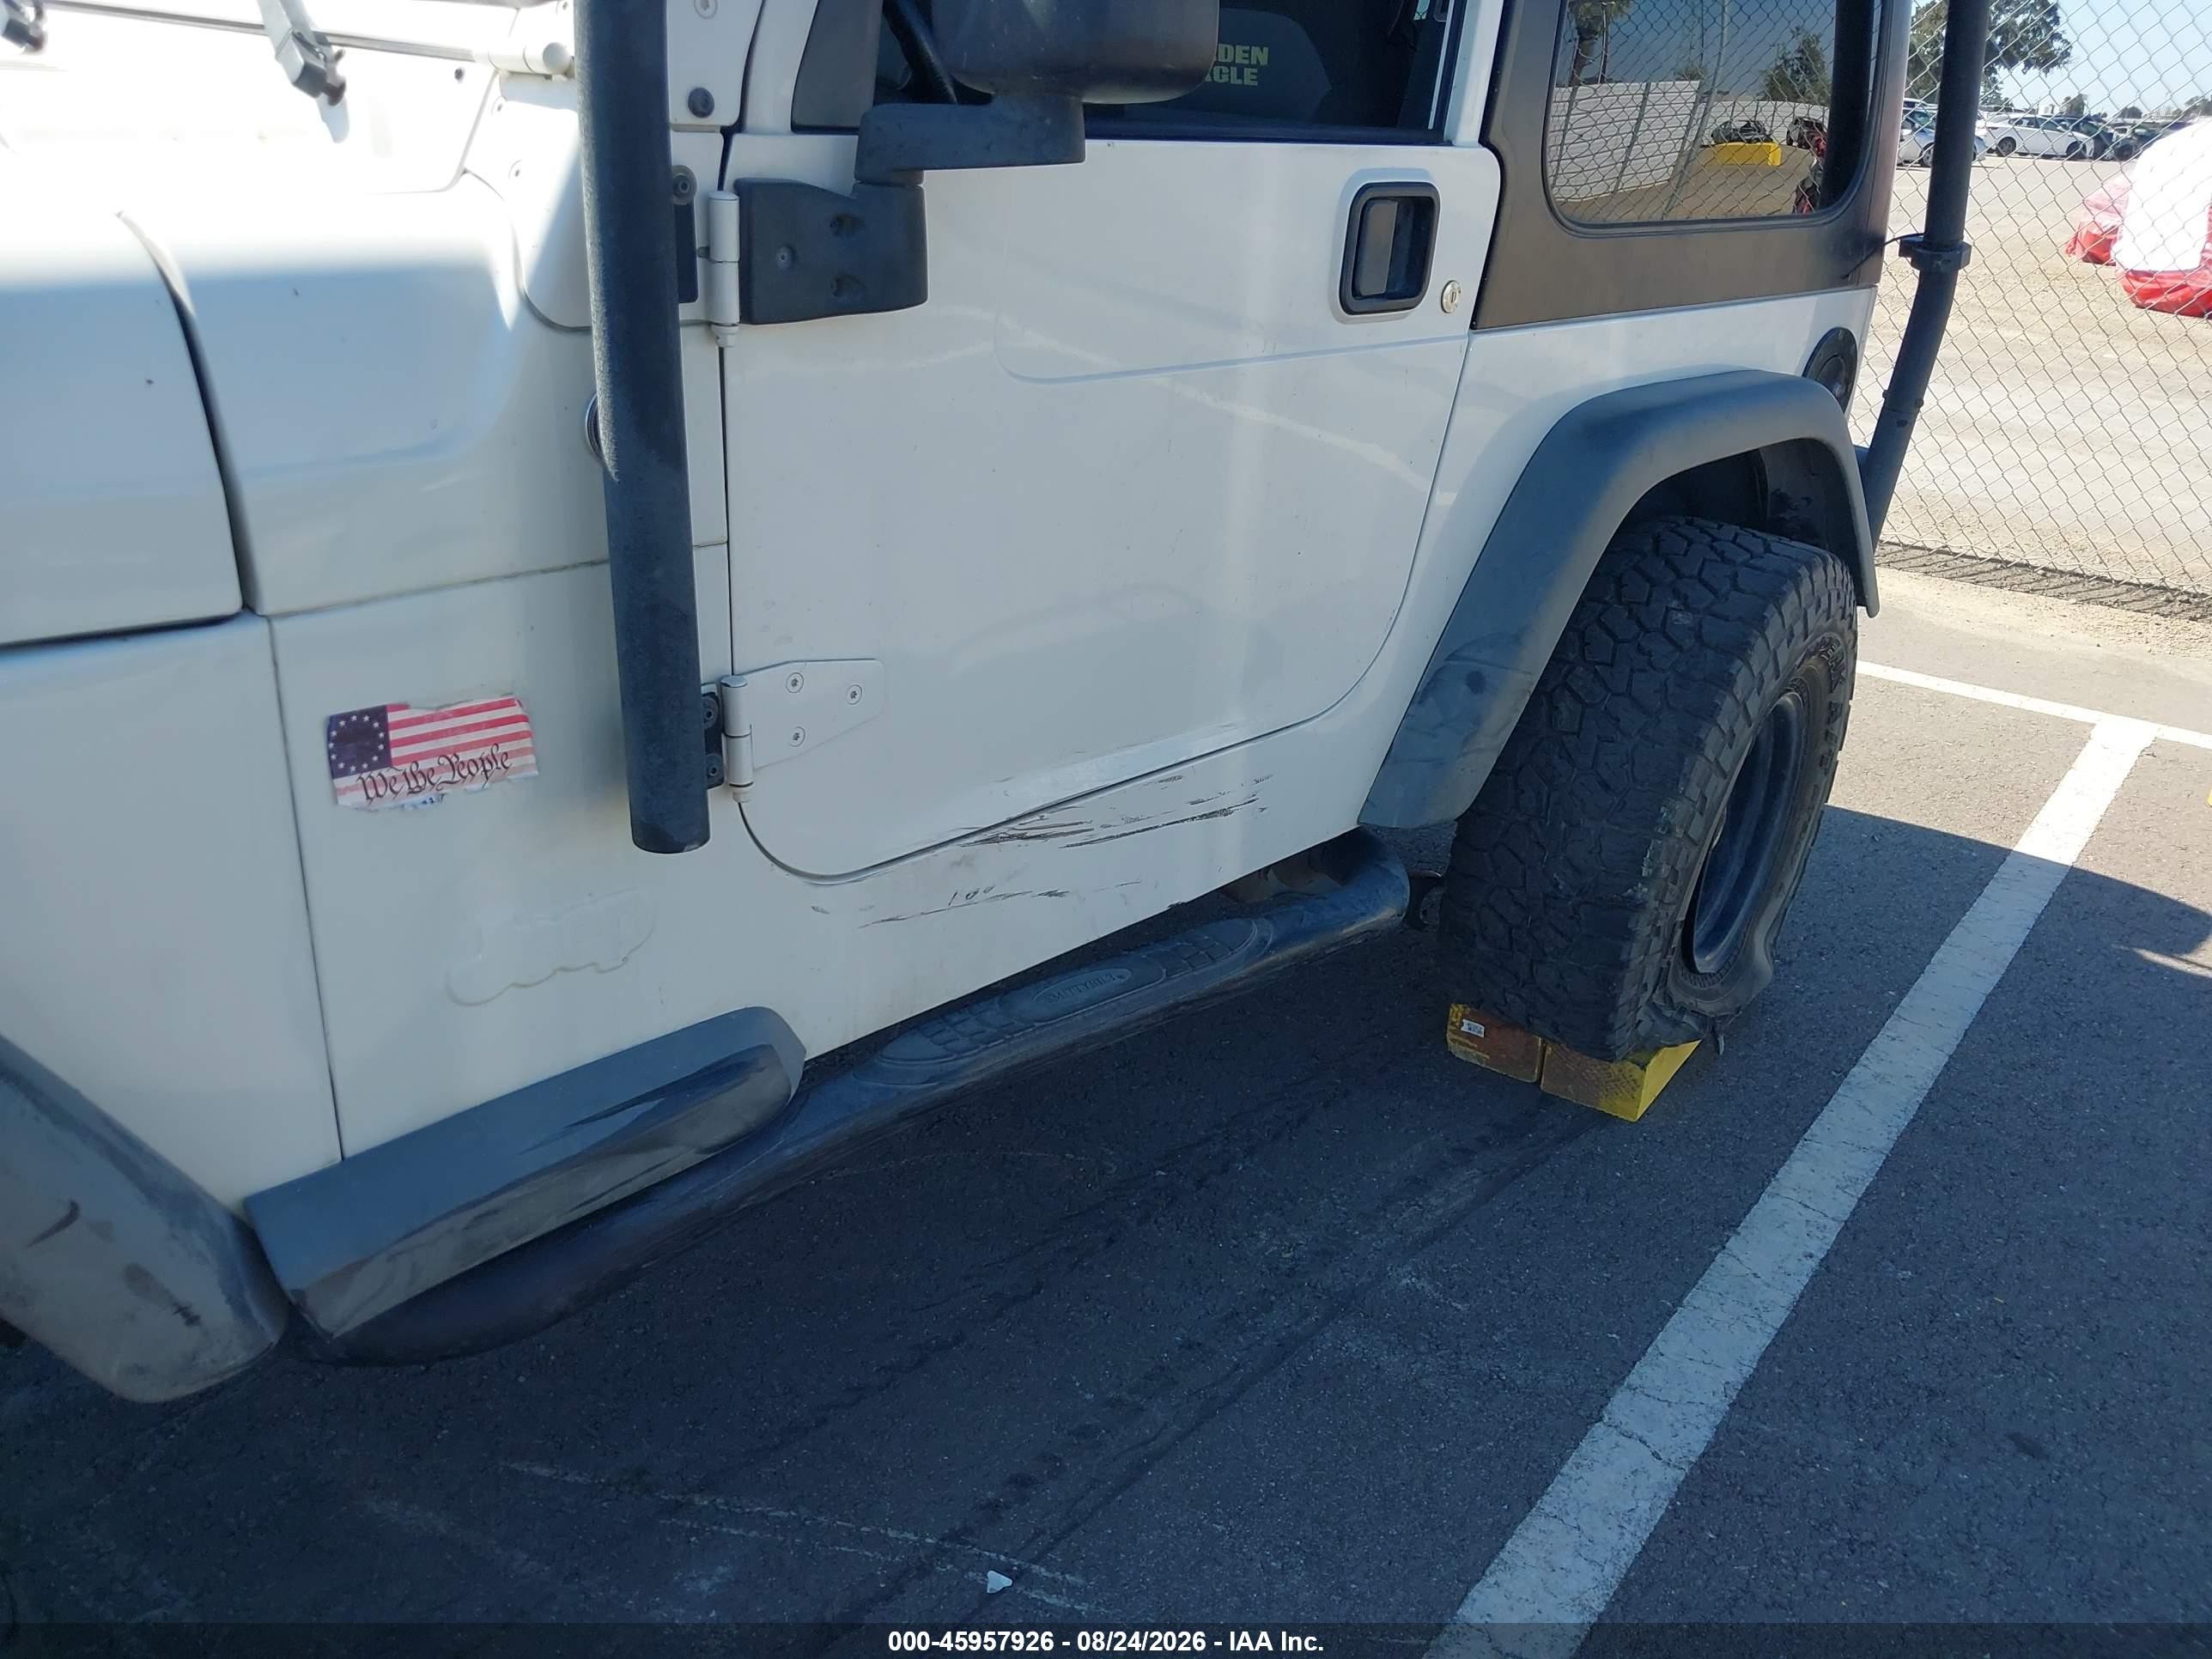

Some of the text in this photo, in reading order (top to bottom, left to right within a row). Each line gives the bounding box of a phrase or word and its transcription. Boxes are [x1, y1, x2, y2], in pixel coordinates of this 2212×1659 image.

[1215, 43, 1269, 66] DEN
[356, 766, 403, 805] We
[435, 743, 514, 791] People
